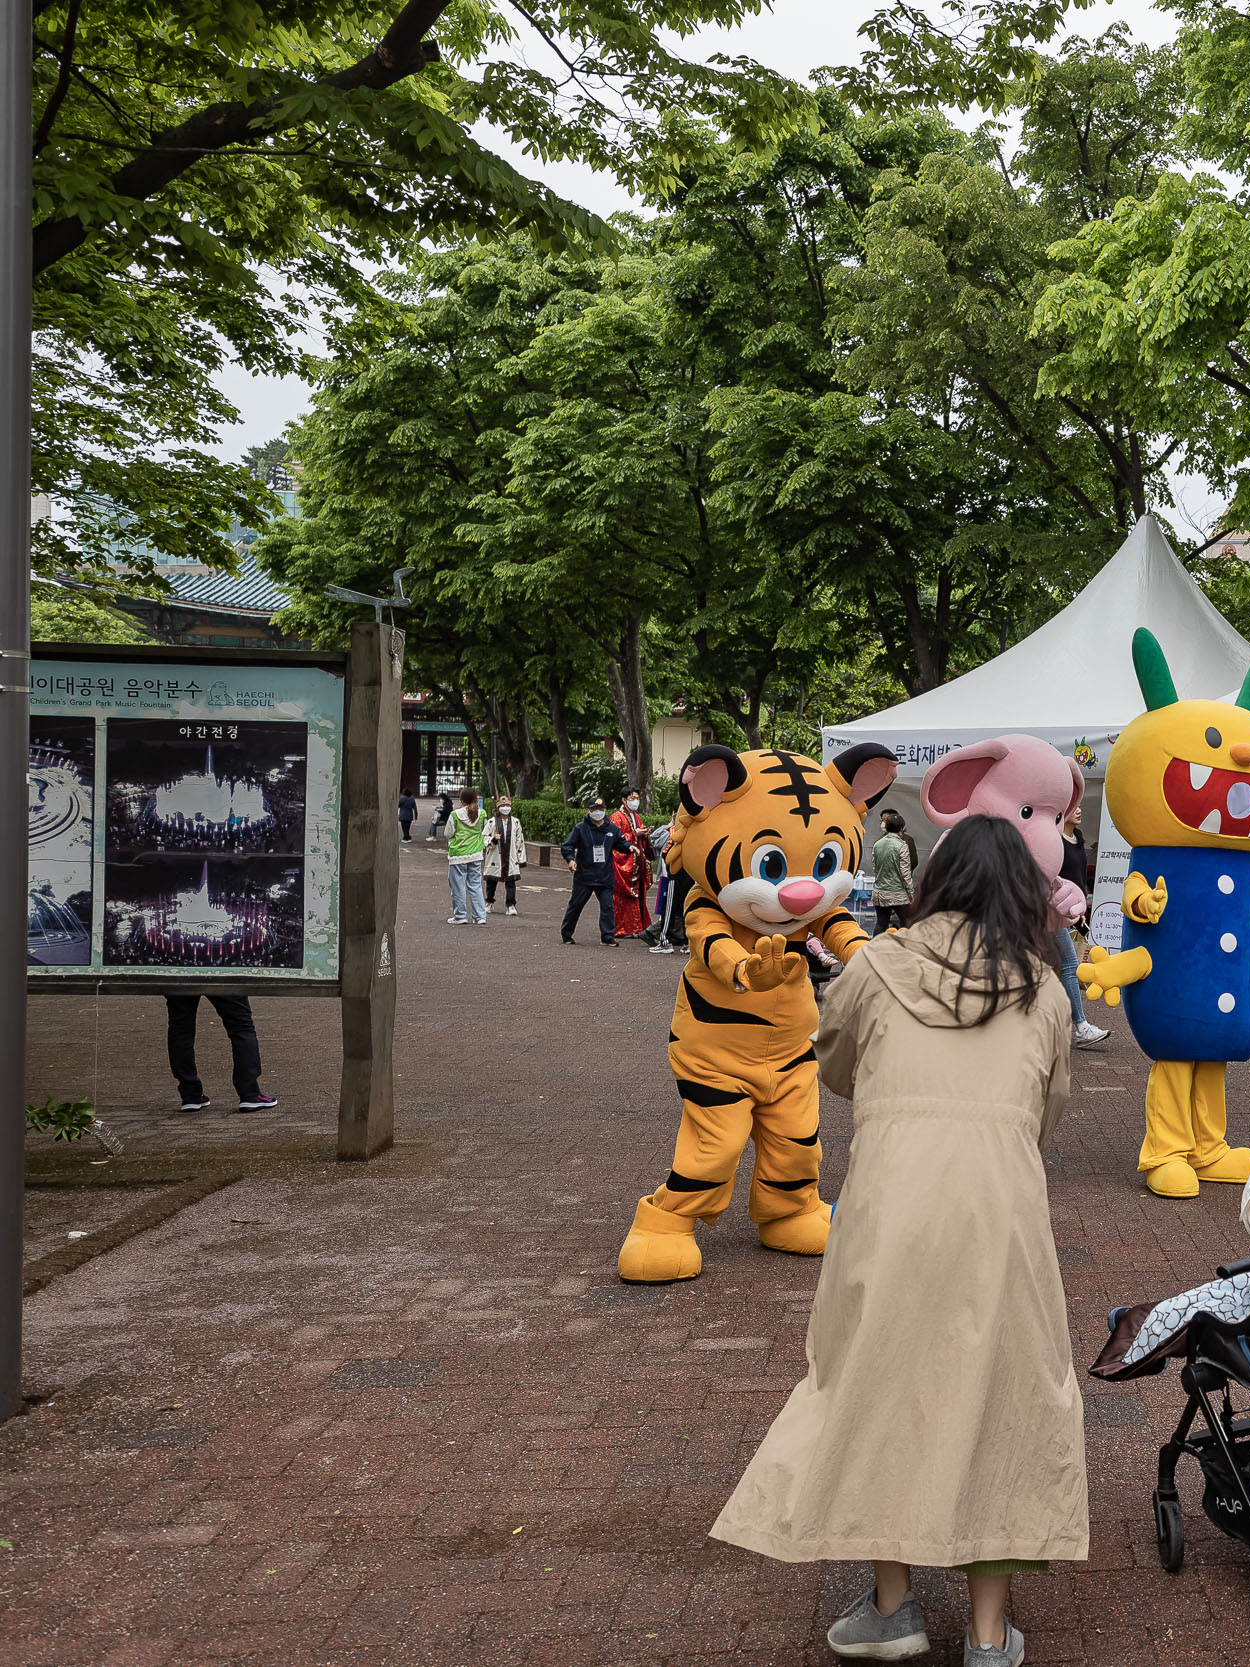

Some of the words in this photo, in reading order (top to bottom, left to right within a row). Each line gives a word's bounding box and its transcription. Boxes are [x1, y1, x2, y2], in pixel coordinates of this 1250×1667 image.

[123, 678, 203, 699] 음악분수
[30, 697, 66, 706] Children's
[95, 699, 112, 707] Park
[895, 743, 963, 766] 문화재발
